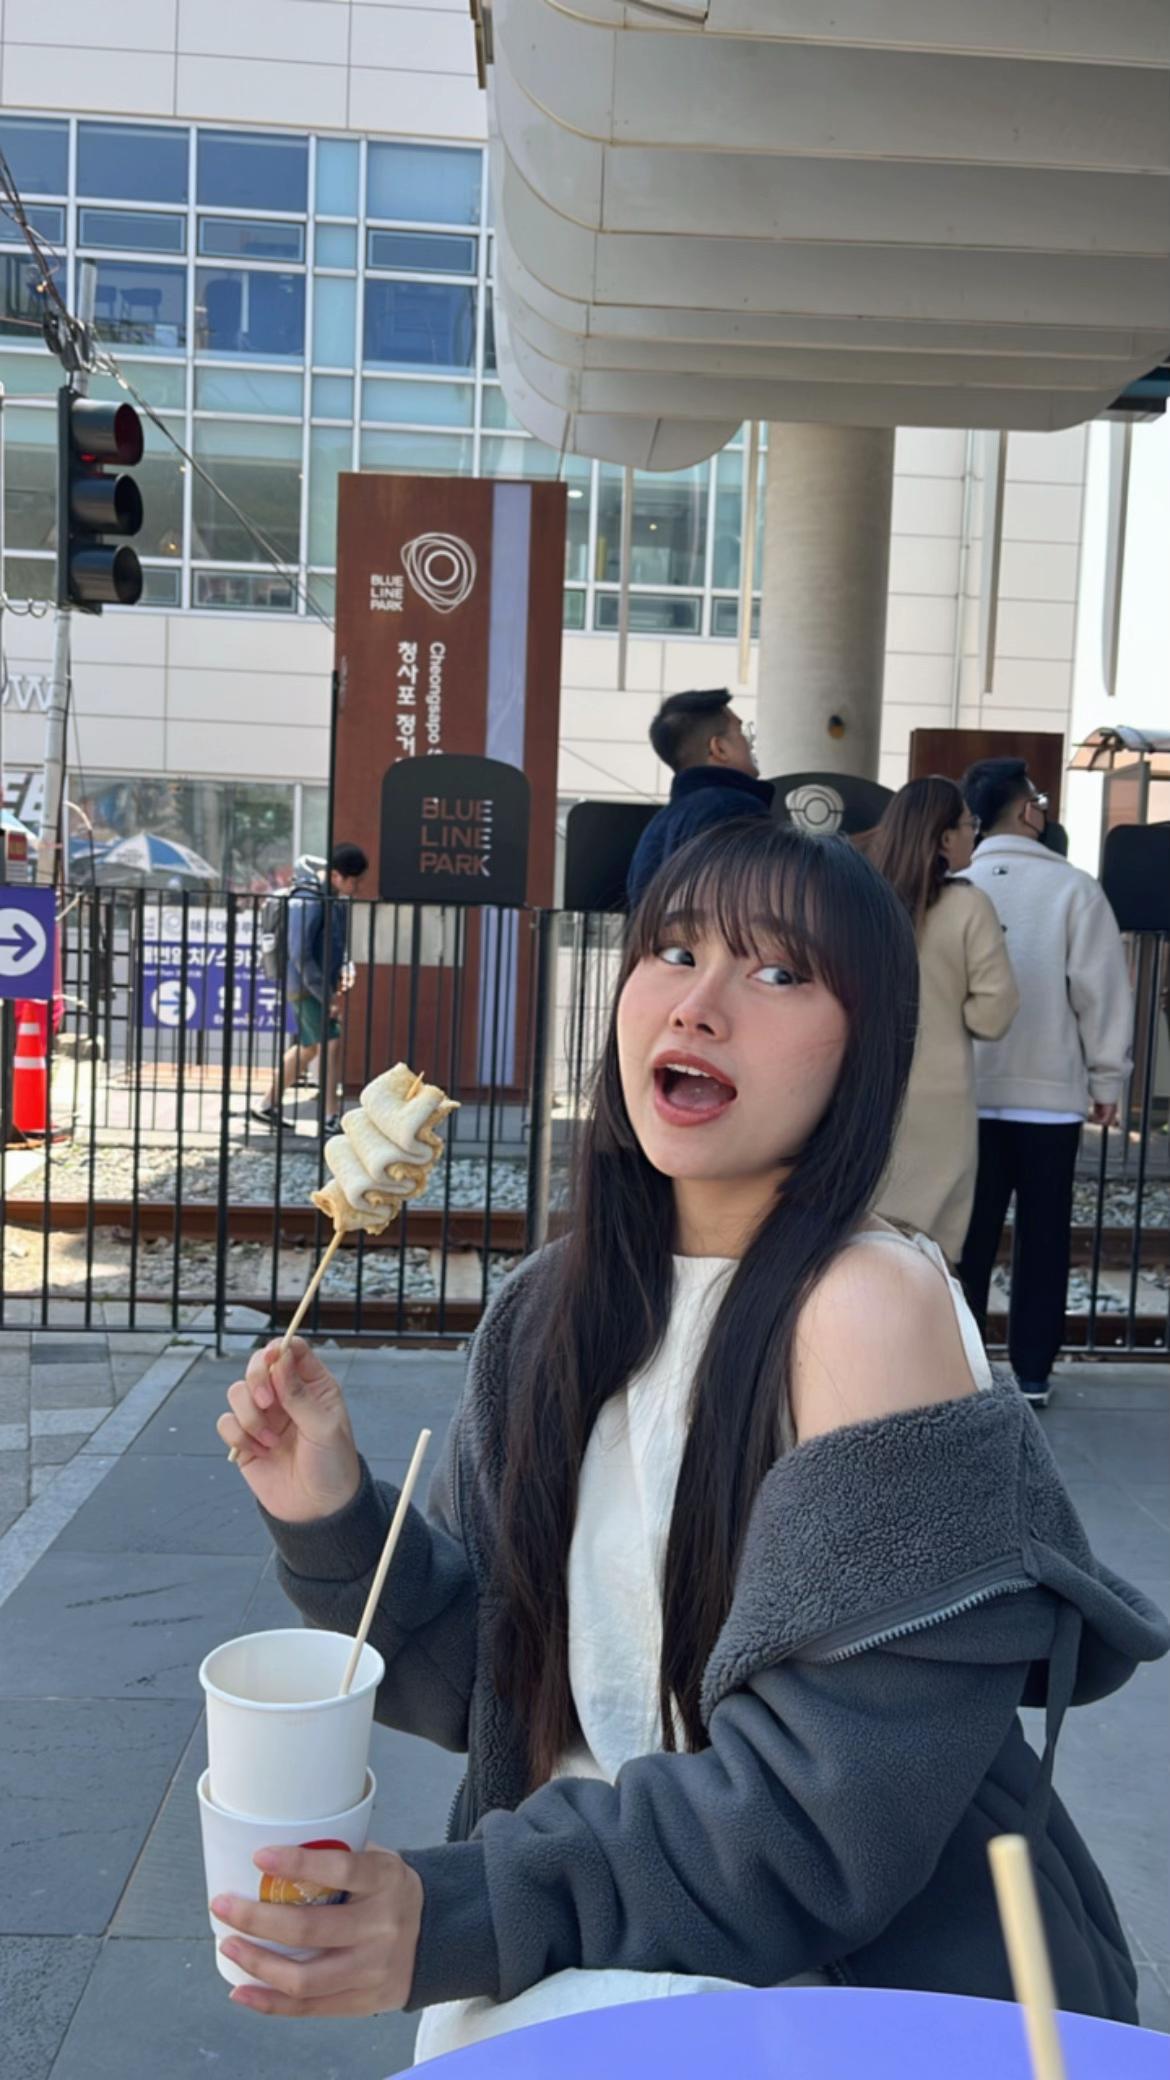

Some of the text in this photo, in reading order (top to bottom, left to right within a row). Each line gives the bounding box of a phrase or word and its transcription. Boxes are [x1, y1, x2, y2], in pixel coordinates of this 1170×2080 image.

[370, 574, 404, 587] BLUE
[370, 587, 404, 599] LINE
[370, 599, 404, 612] PARK
[395, 640, 419, 763] 청사포 정거
[425, 641, 446, 744] Cheongsapo
[421, 796, 494, 823] BLUE
[420, 825, 492, 850] LINE
[419, 851, 491, 877] PARK
